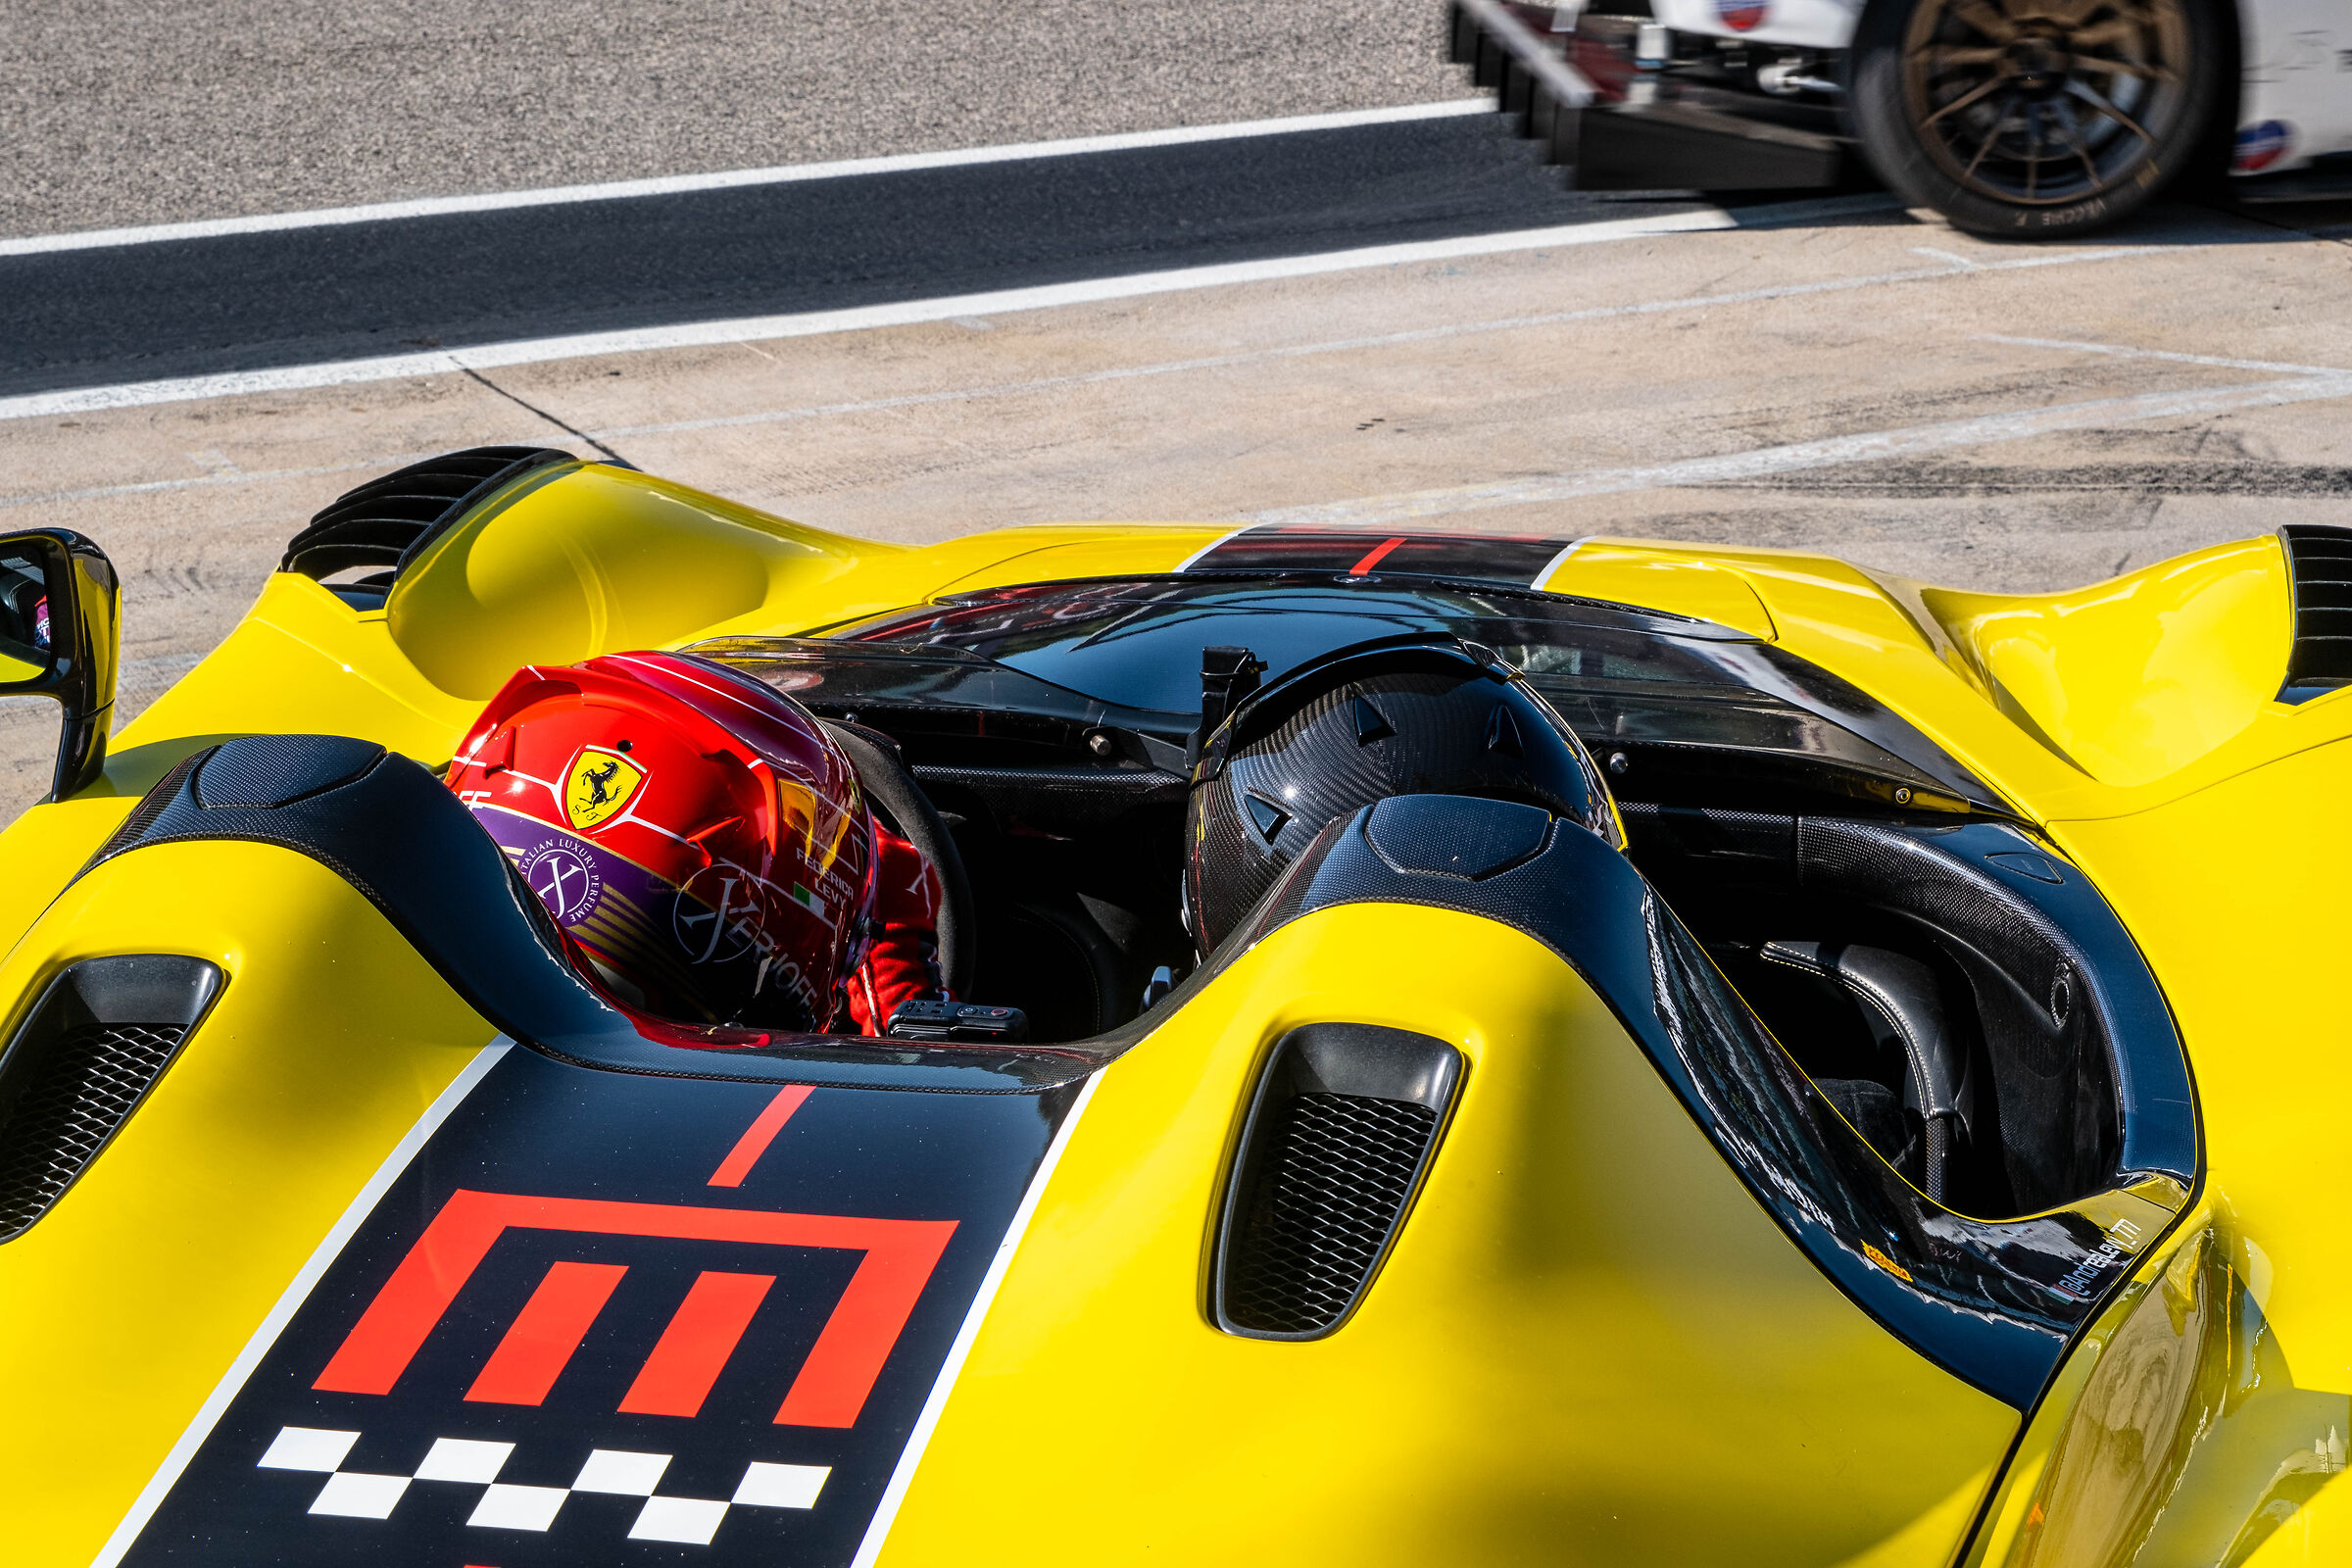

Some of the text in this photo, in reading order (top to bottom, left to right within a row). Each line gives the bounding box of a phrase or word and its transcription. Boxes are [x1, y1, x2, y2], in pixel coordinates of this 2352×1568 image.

[520, 839, 600, 922] ITALIAN LUXURY PERFUME
[814, 877, 846, 909] LEVY
